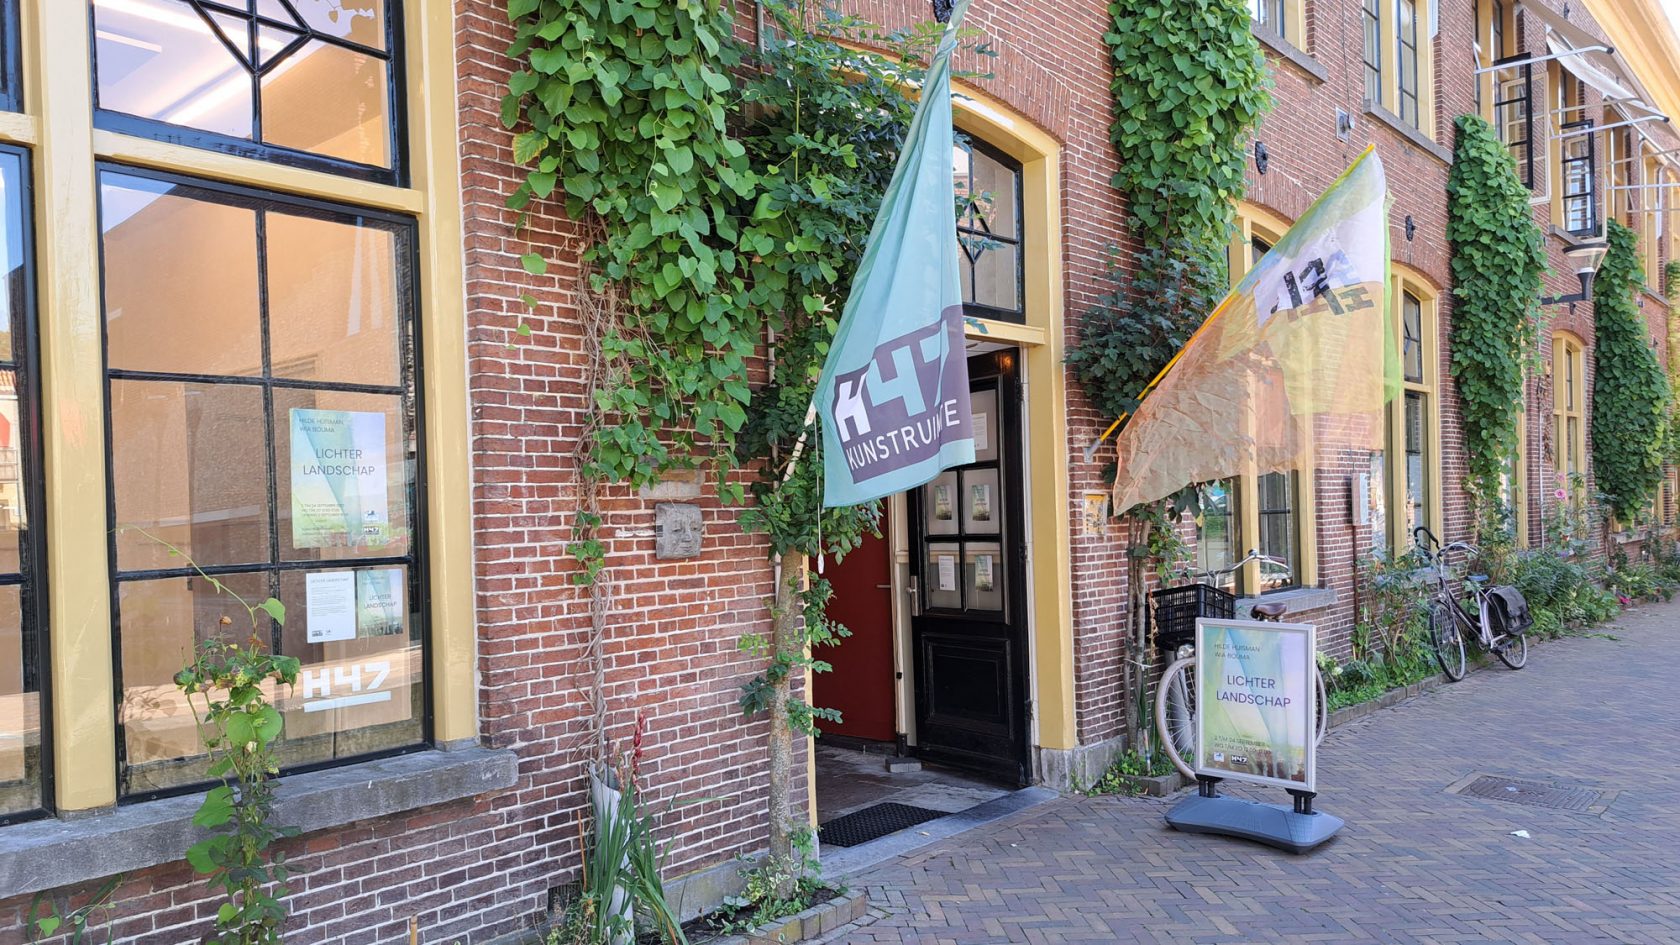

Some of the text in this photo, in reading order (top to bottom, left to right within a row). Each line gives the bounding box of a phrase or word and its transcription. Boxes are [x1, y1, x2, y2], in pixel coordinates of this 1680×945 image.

[846, 399, 960, 471] KUNSTRUIE
[316, 449, 363, 460] LICHTER
[303, 465, 376, 476] LANDSCHAP
[302, 661, 392, 699] H47
[1227, 675, 1276, 690] LICHTER
[1216, 691, 1291, 708] LANDSCHAP
